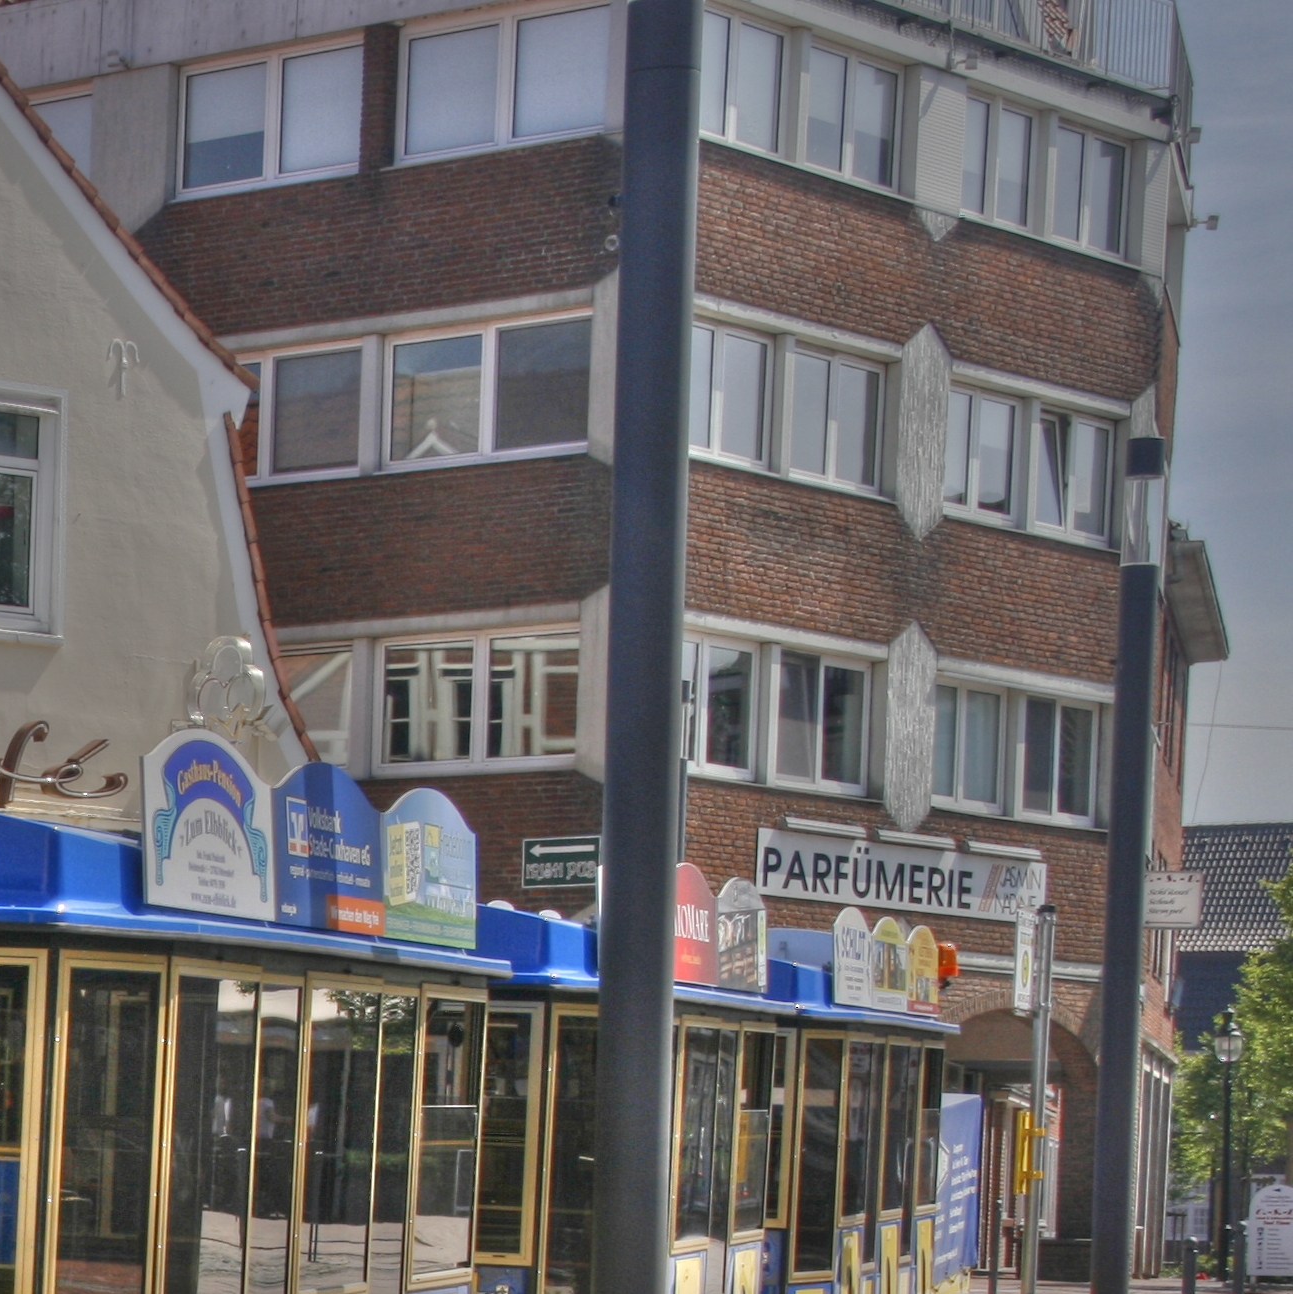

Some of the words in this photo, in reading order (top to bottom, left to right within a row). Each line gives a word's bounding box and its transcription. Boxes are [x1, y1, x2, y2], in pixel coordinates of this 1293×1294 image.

[307, 806, 341, 834] Volksbank
[309, 834, 360, 865] Stade-Cuxhaven
[762, 846, 973, 910] PARFÜMERIE
[1000, 865, 1043, 891] JASMIN
